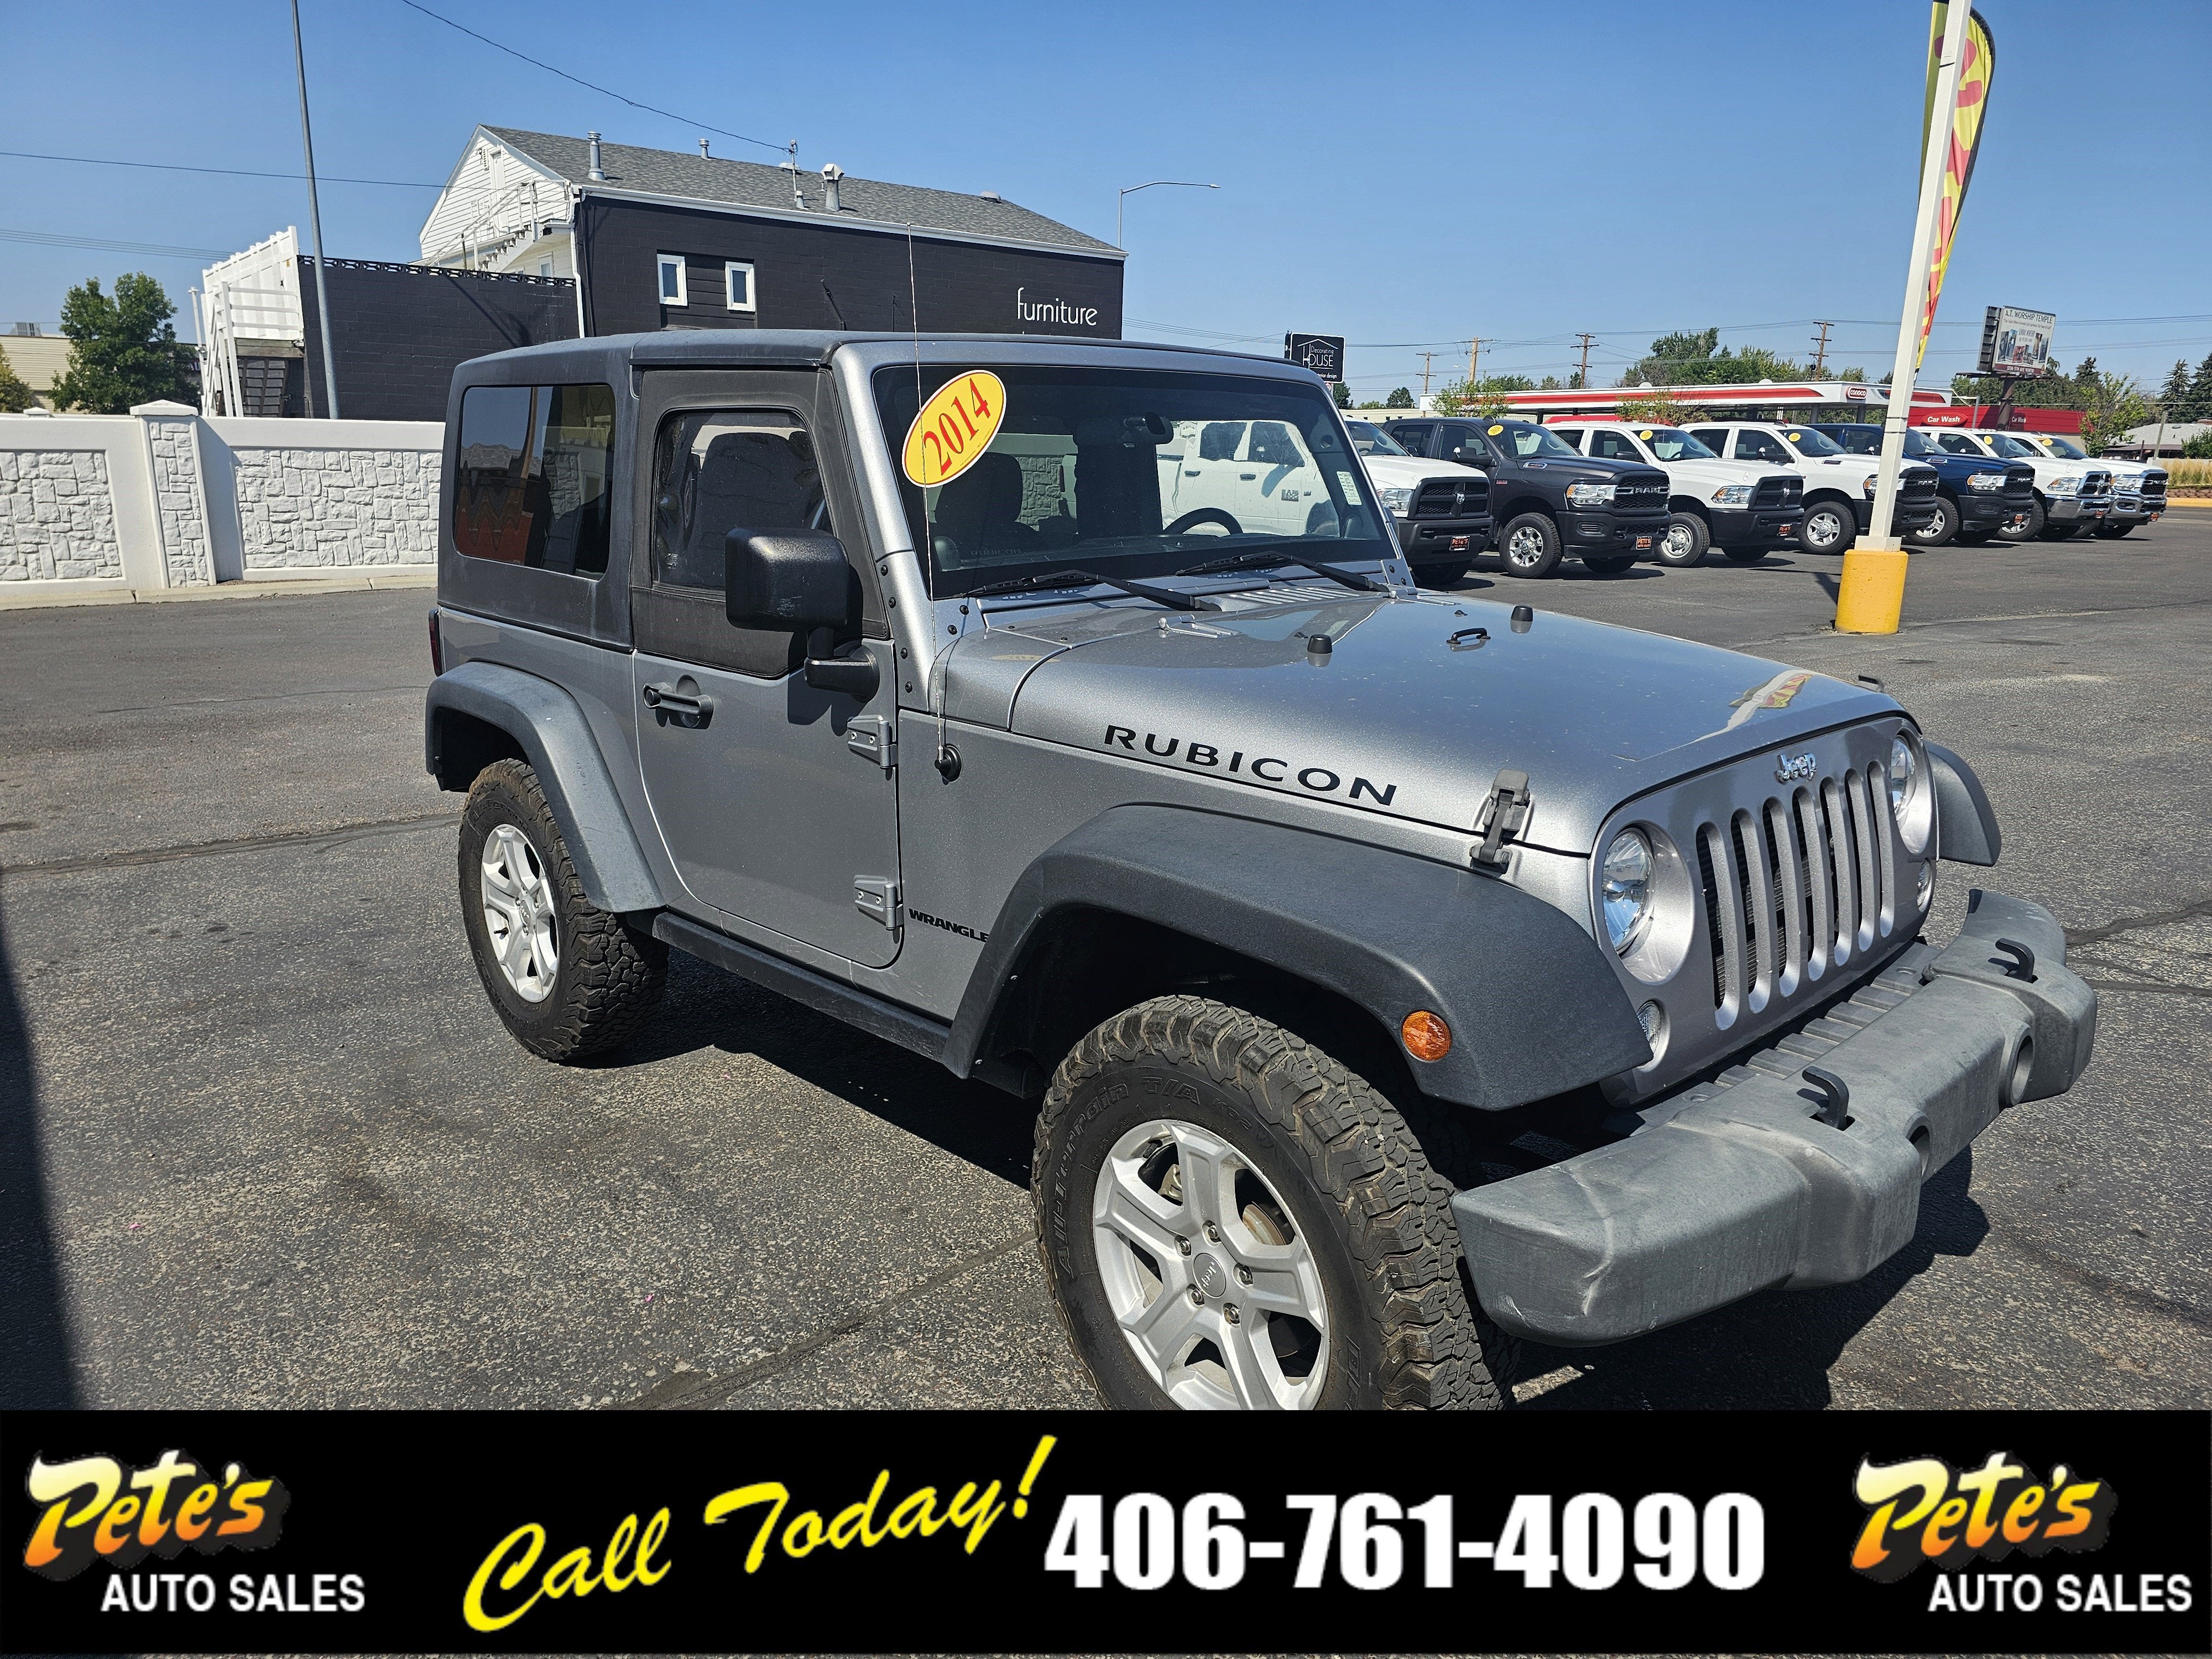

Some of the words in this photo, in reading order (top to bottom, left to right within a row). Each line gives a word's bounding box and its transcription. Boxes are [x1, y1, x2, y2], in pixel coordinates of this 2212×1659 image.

[1018, 287, 1098, 326] furniture
[2015, 311, 2035, 320] WORSHIP
[2036, 314, 2052, 324] TEMPLE
[1311, 345, 1334, 355] Decorating
[924, 378, 990, 476] 2014
[1104, 724, 1397, 806] RUBICON
[1775, 753, 1817, 783] Jeep
[909, 908, 990, 943] WRANGLE
